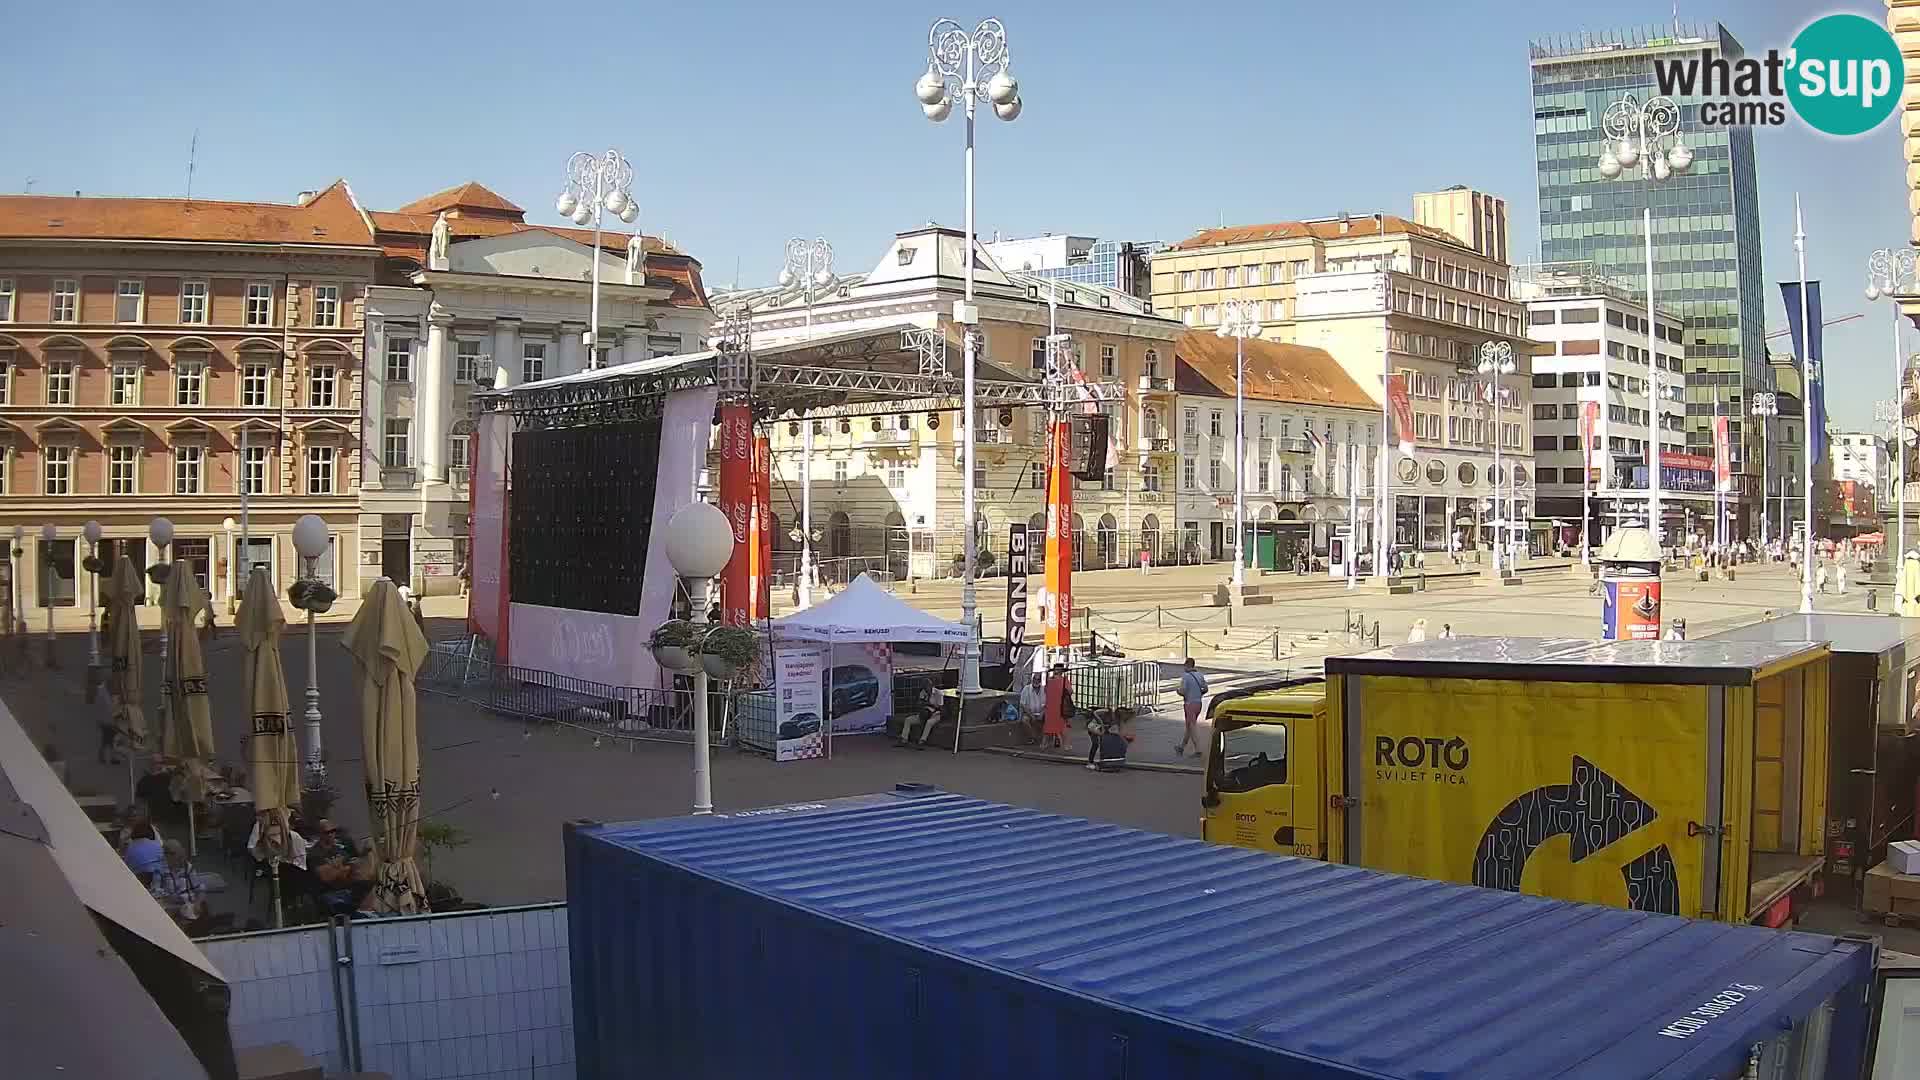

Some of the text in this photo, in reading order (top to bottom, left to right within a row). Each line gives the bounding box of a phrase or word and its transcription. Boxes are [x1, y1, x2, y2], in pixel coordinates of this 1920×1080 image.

[1009, 532, 1026, 674] BENUSS
[1376, 736, 1469, 771] ROTO
[1376, 771, 1426, 782] SVIJET
[1235, 812, 1257, 823] ROTO
[1294, 843, 1312, 857] 203
[1691, 990, 1746, 1019] 300629
